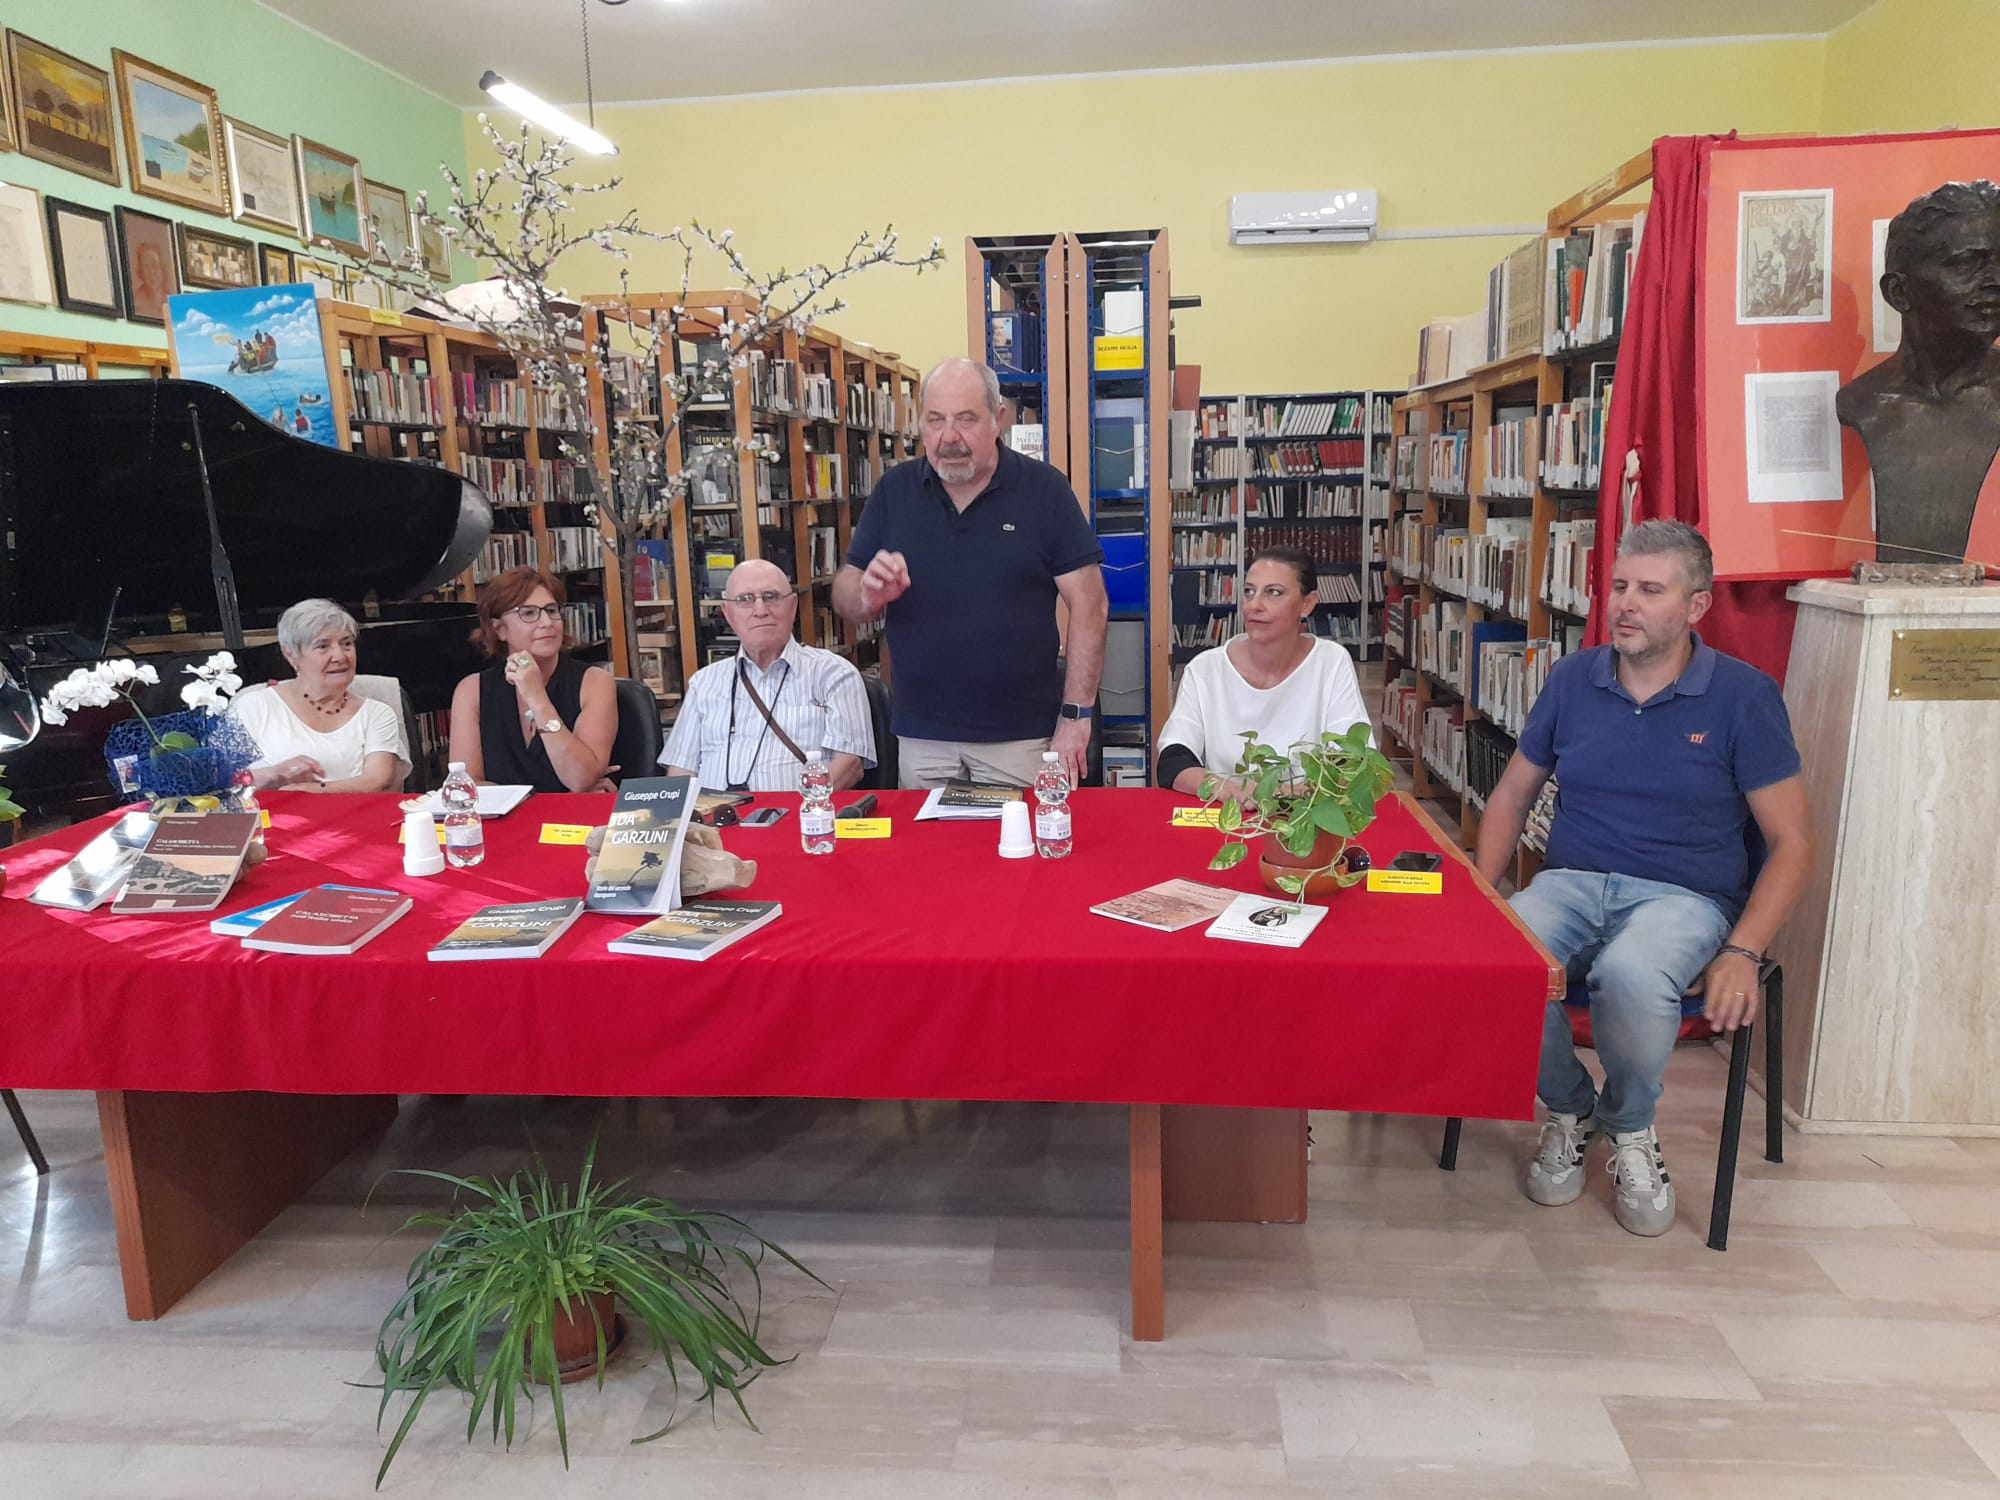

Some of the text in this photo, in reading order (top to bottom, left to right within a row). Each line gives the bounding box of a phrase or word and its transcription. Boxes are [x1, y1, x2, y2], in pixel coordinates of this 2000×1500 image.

[624, 789, 680, 801] Giuseppe Crupi
[617, 814, 635, 825] DA
[611, 830, 669, 844] GARZUNI
[488, 904, 567, 915] Giuseppe Crupi
[693, 904, 735, 912] Giuseppe
[471, 920, 553, 929] GARZUNI
[666, 917, 738, 929] GARZUNI
